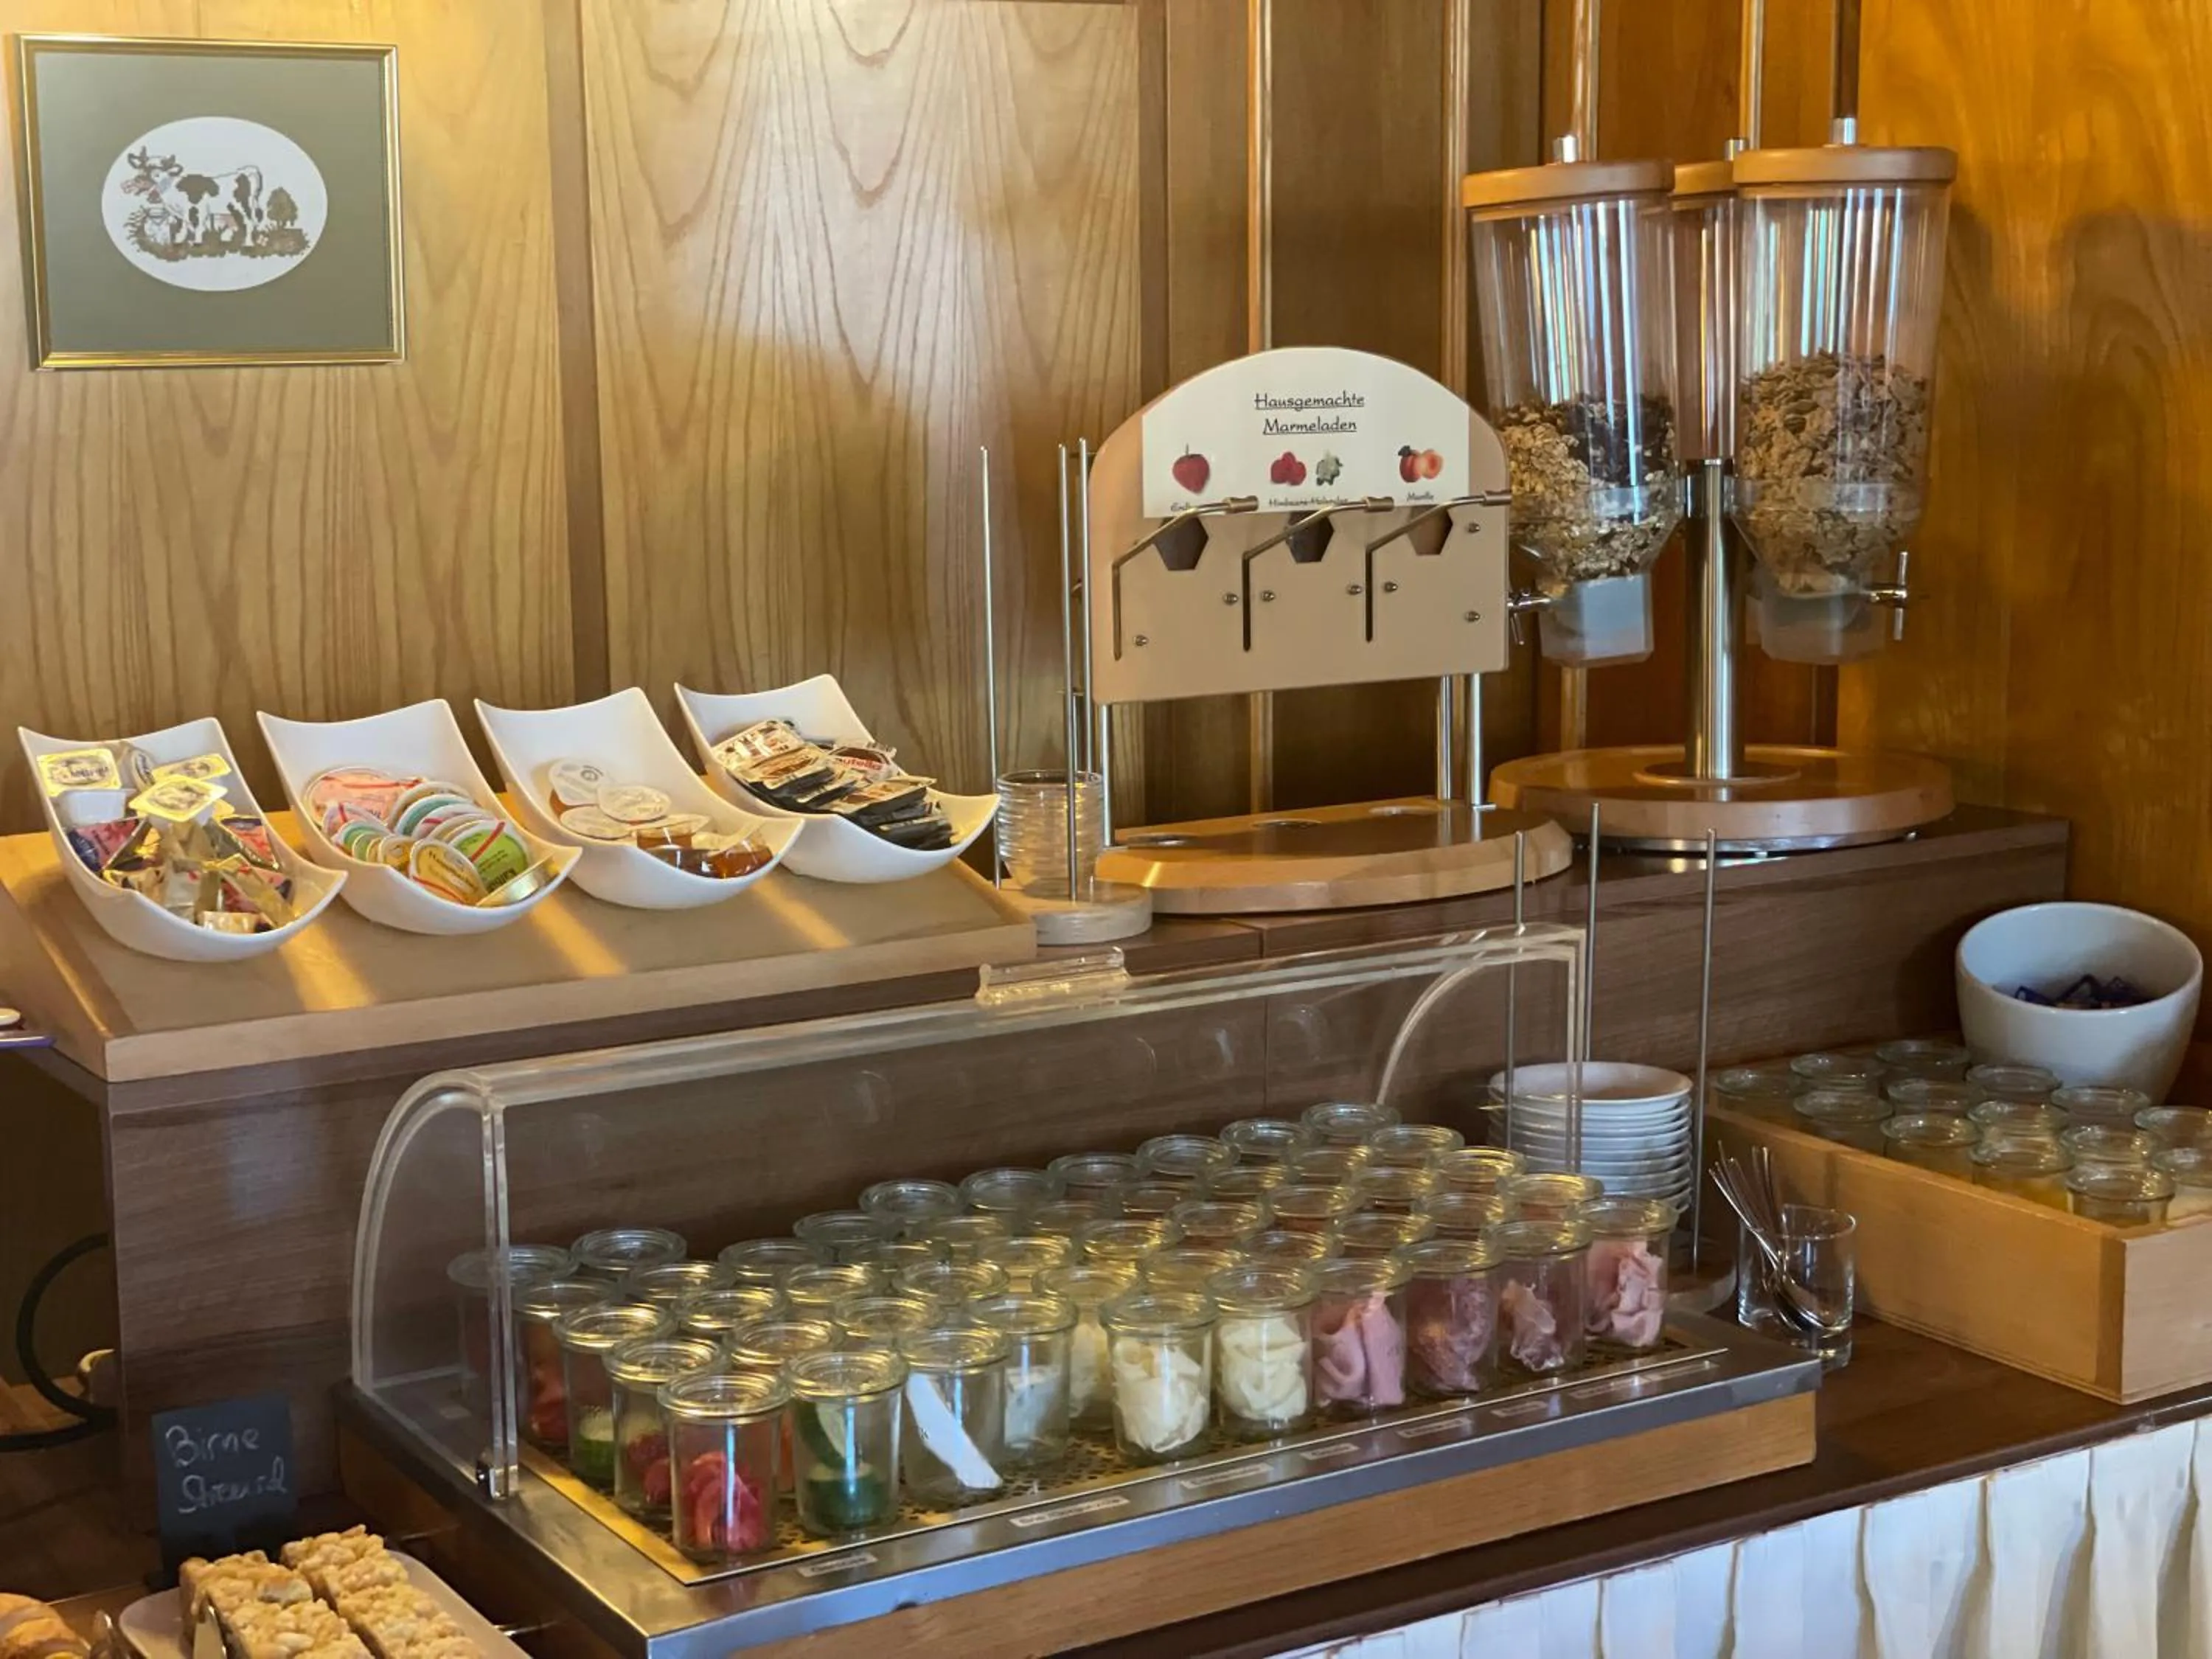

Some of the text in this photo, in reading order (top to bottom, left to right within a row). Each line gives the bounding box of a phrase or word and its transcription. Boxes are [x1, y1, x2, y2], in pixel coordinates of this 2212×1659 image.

[1254, 389, 1365, 411] Hausgemachte
[1262, 416, 1357, 434] Marmeladen
[165, 1425, 259, 1467] Birne
